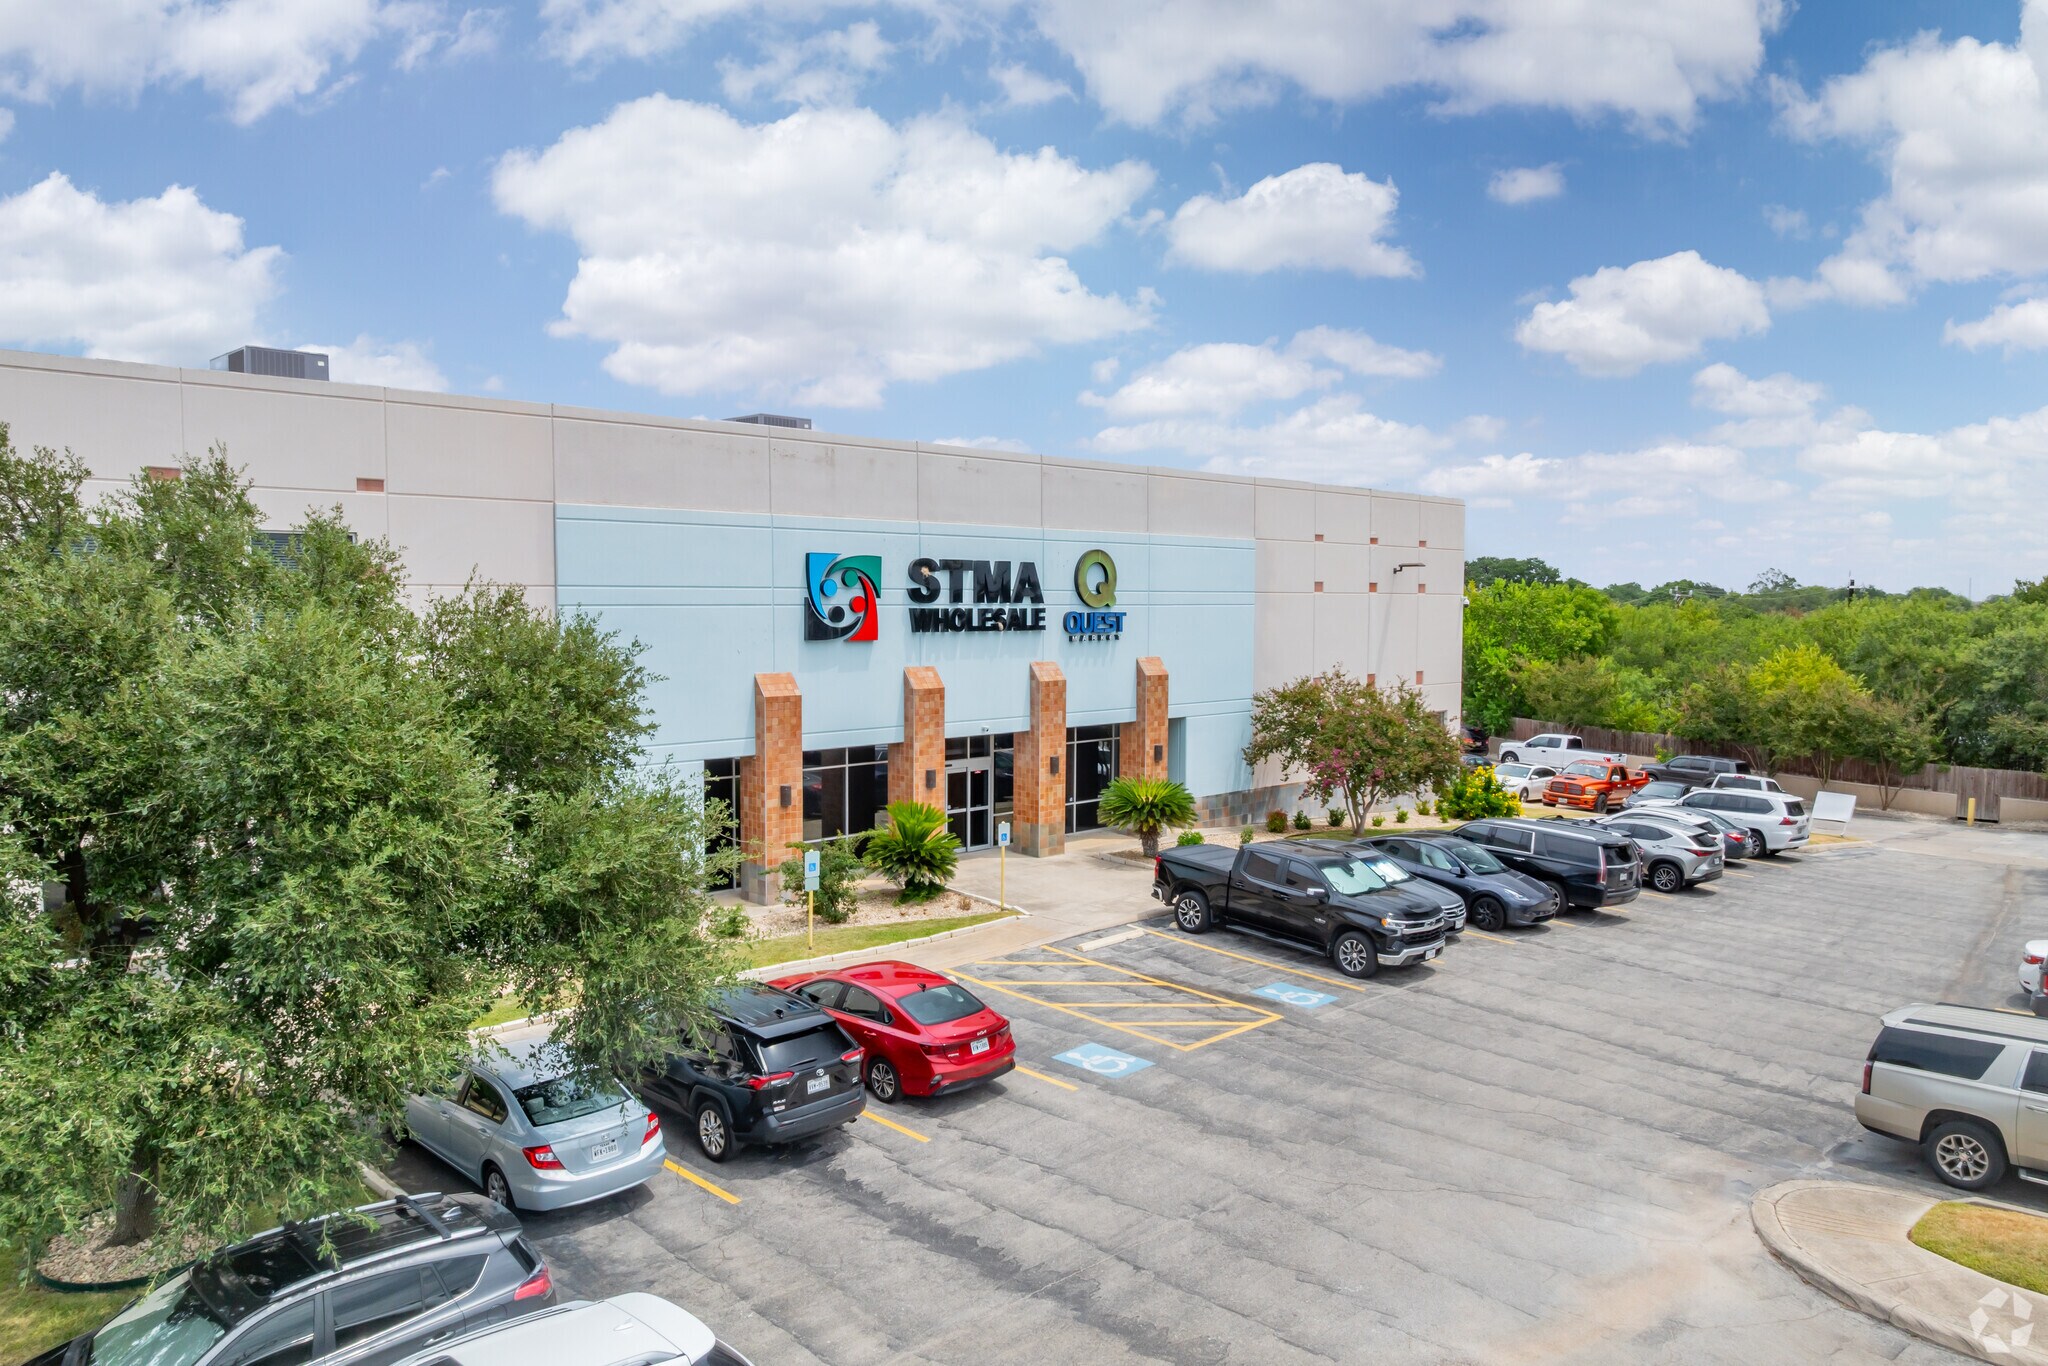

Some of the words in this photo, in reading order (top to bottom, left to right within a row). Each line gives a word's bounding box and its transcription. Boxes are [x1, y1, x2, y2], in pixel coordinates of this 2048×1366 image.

[906, 557, 1045, 604] STMA
[1074, 549, 1117, 608] Q
[908, 607, 1047, 633] WHOLESALE
